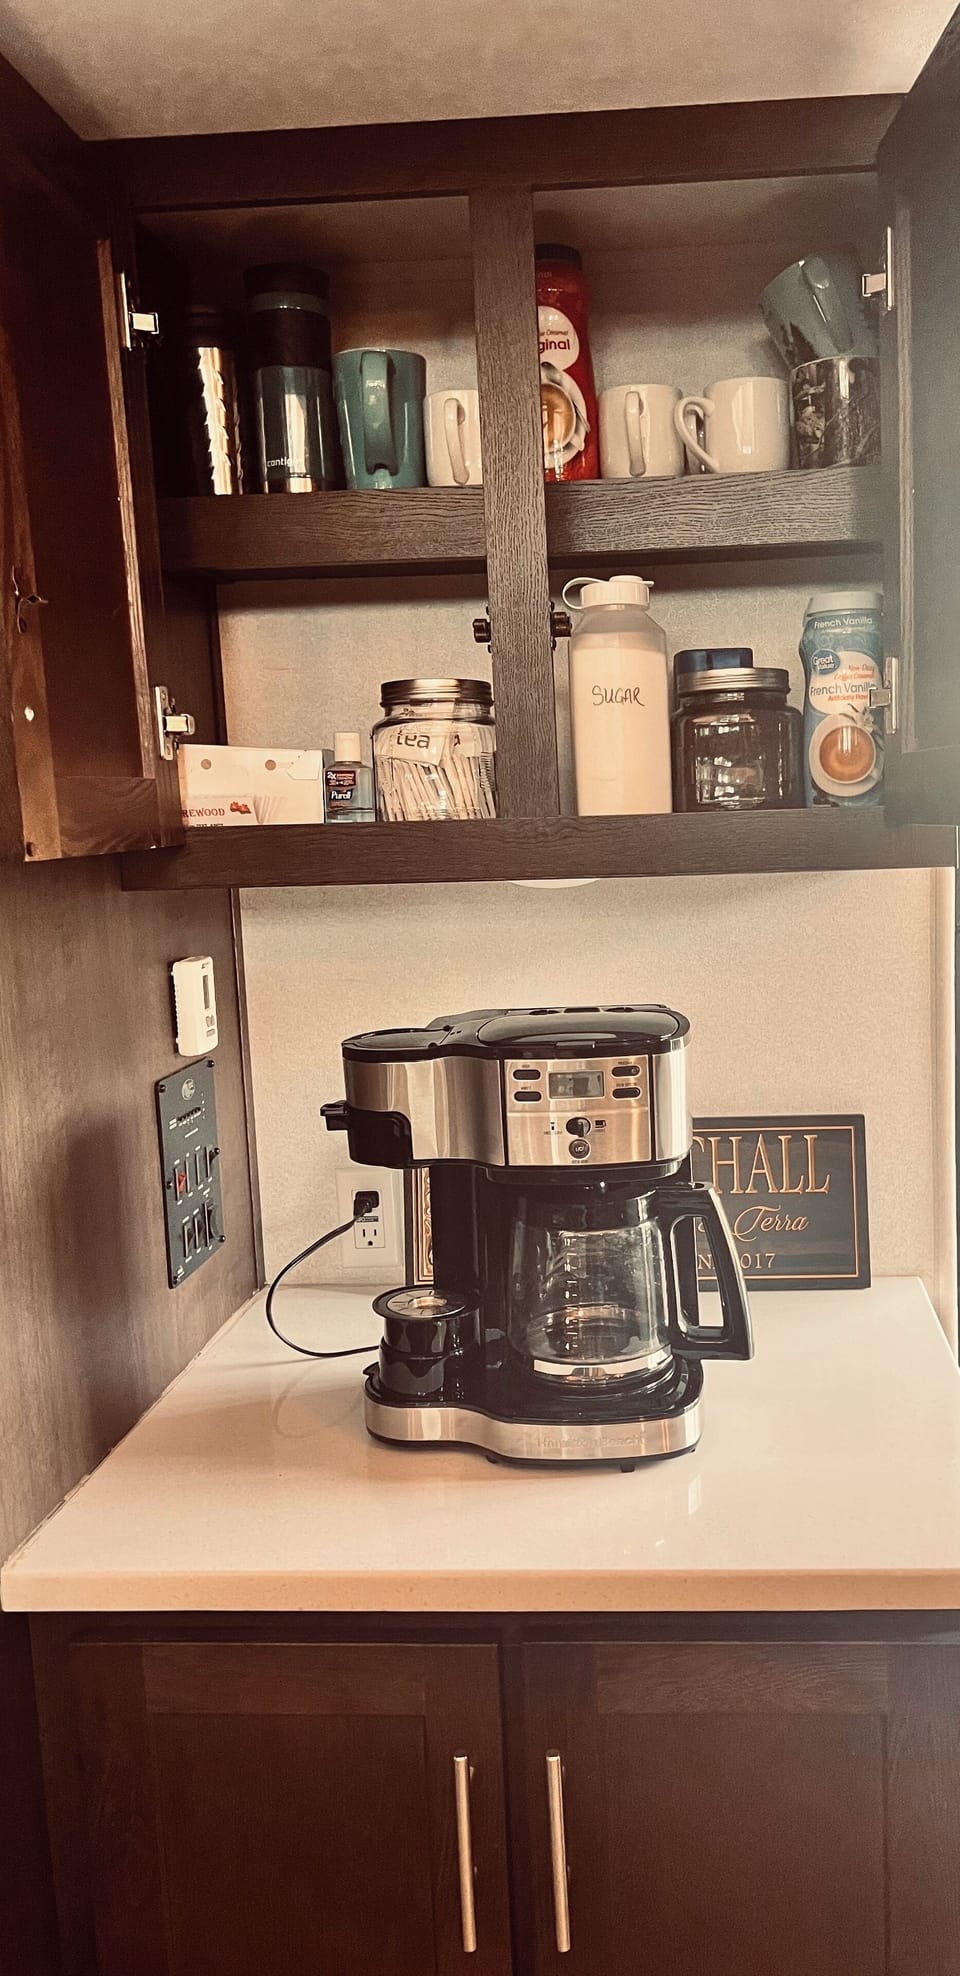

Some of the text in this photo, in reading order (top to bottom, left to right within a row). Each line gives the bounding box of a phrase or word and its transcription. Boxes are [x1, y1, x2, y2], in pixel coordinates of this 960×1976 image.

[539, 338, 570, 353] ginal
[267, 456, 293, 468] contig
[814, 616, 873, 629] French Vanilla
[813, 655, 834, 666] Great
[591, 684, 646, 707] SUGAR
[810, 683, 842, 697] French
[396, 730, 431, 750] tea
[182, 807, 225, 818] REWOOD
[692, 1133, 830, 1195] HALL
[731, 1204, 809, 1242] Terra
[740, 1252, 776, 1269] 017
